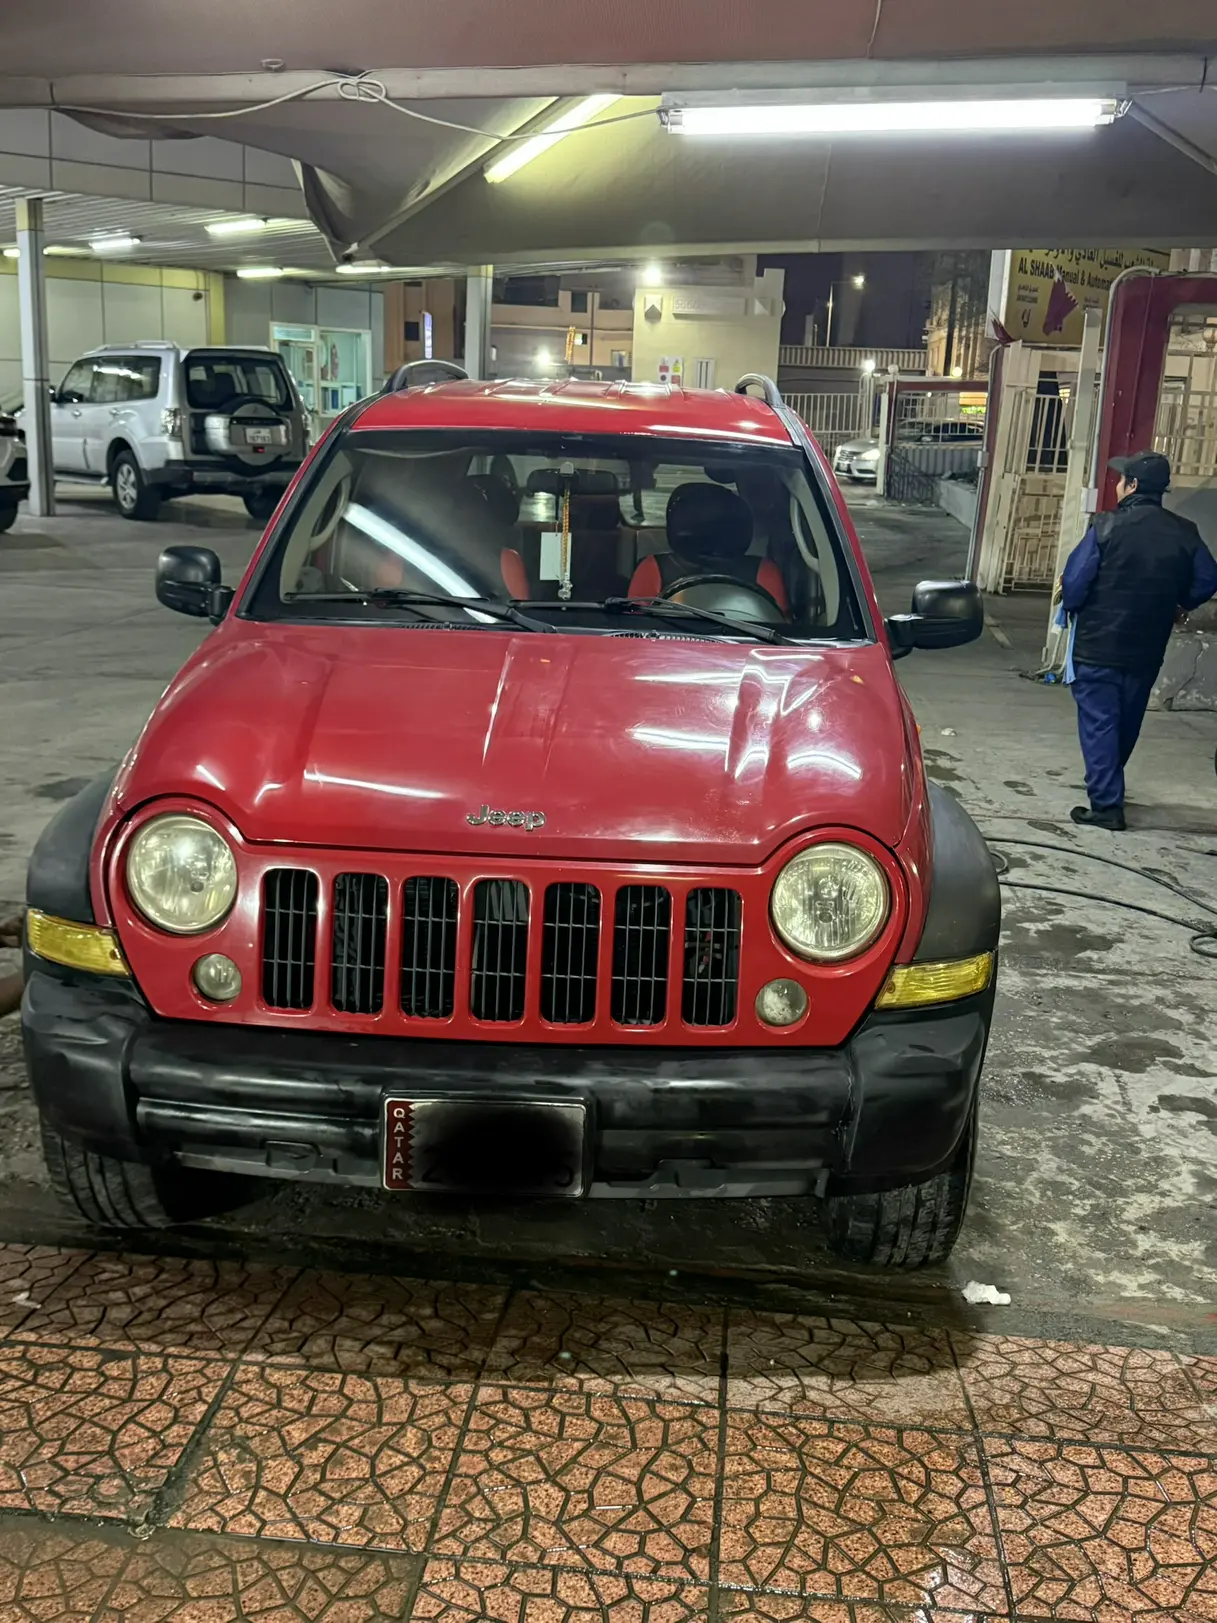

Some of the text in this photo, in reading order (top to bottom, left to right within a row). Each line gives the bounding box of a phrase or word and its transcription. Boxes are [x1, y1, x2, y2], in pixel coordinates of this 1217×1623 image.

[1018, 257, 1028, 274] AL
[1030, 259, 1055, 280] SHAAB
[1056, 264, 1079, 285] Manual
[1080, 270, 1085, 286] &
[465, 804, 546, 832] Jeep
[391, 1107, 406, 1180] QATAR
